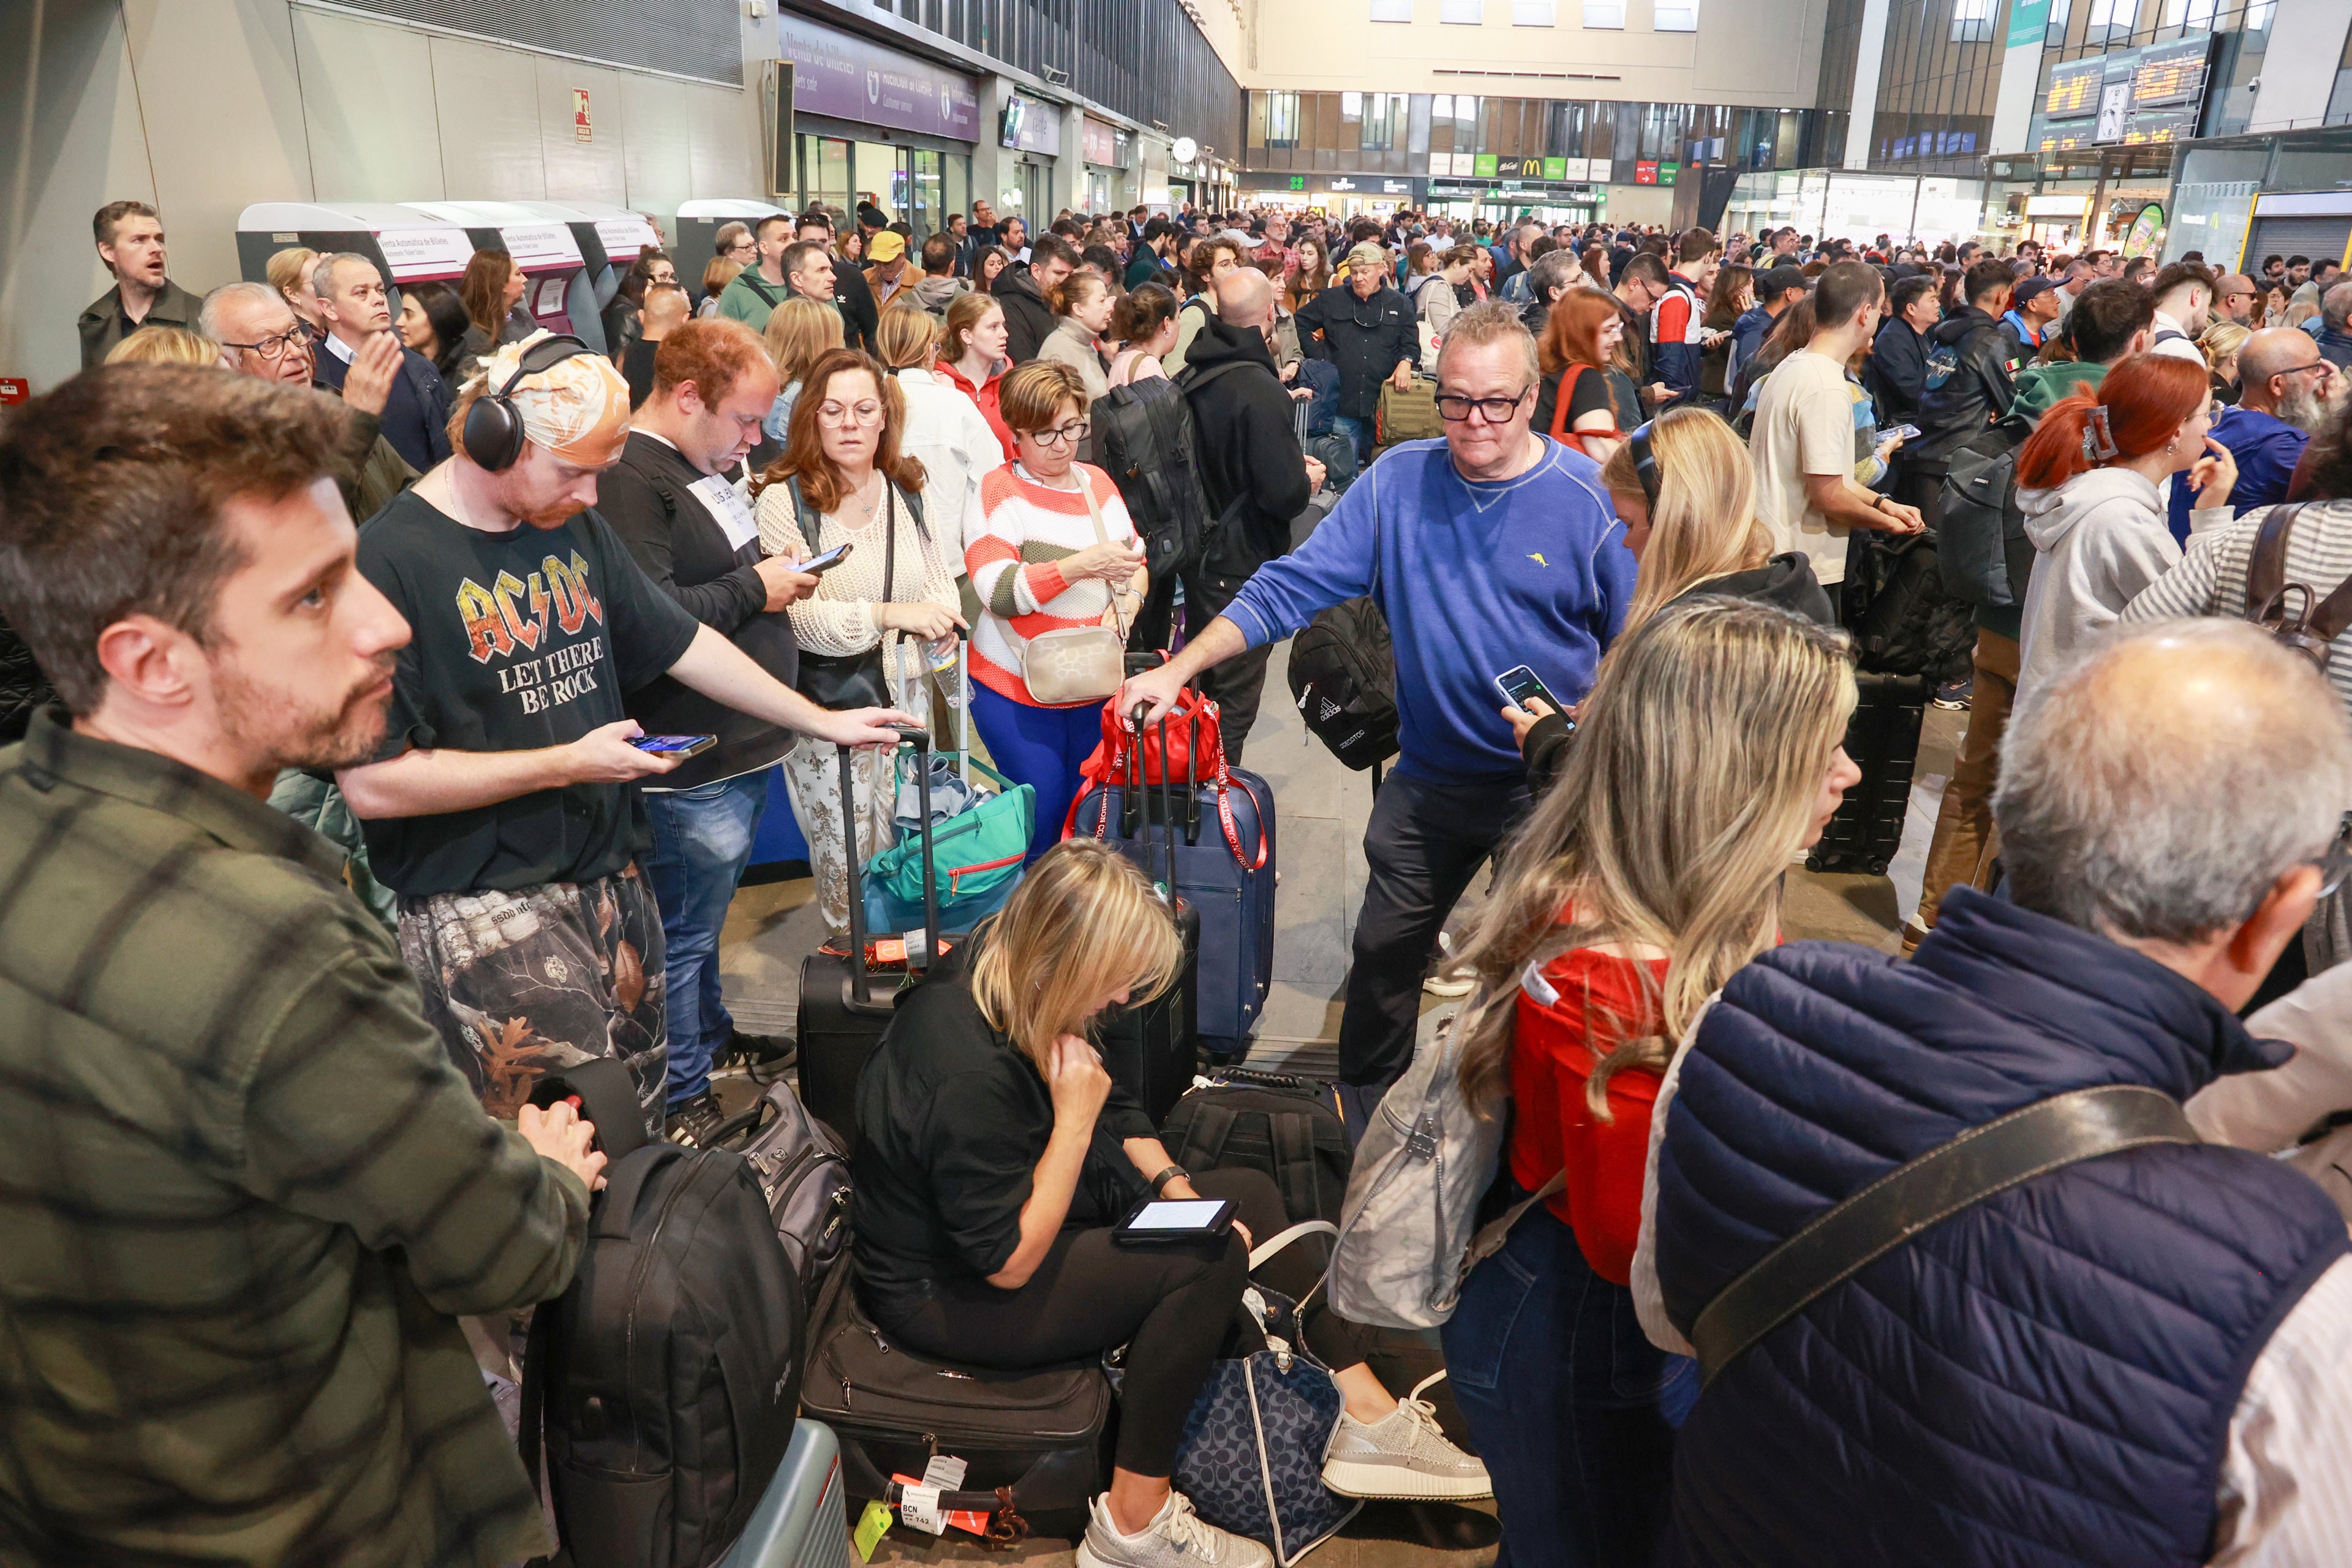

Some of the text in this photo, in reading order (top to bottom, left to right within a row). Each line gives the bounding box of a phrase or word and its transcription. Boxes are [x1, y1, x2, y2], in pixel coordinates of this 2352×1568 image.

[786, 32, 854, 75] Venta de billetes
[380, 239, 396, 247] Venta
[497, 636, 603, 694] LET THERE
[519, 666, 598, 715] BE ROCK
[1320, 704, 1341, 722] adidas
[903, 1504, 918, 1513] BCN
